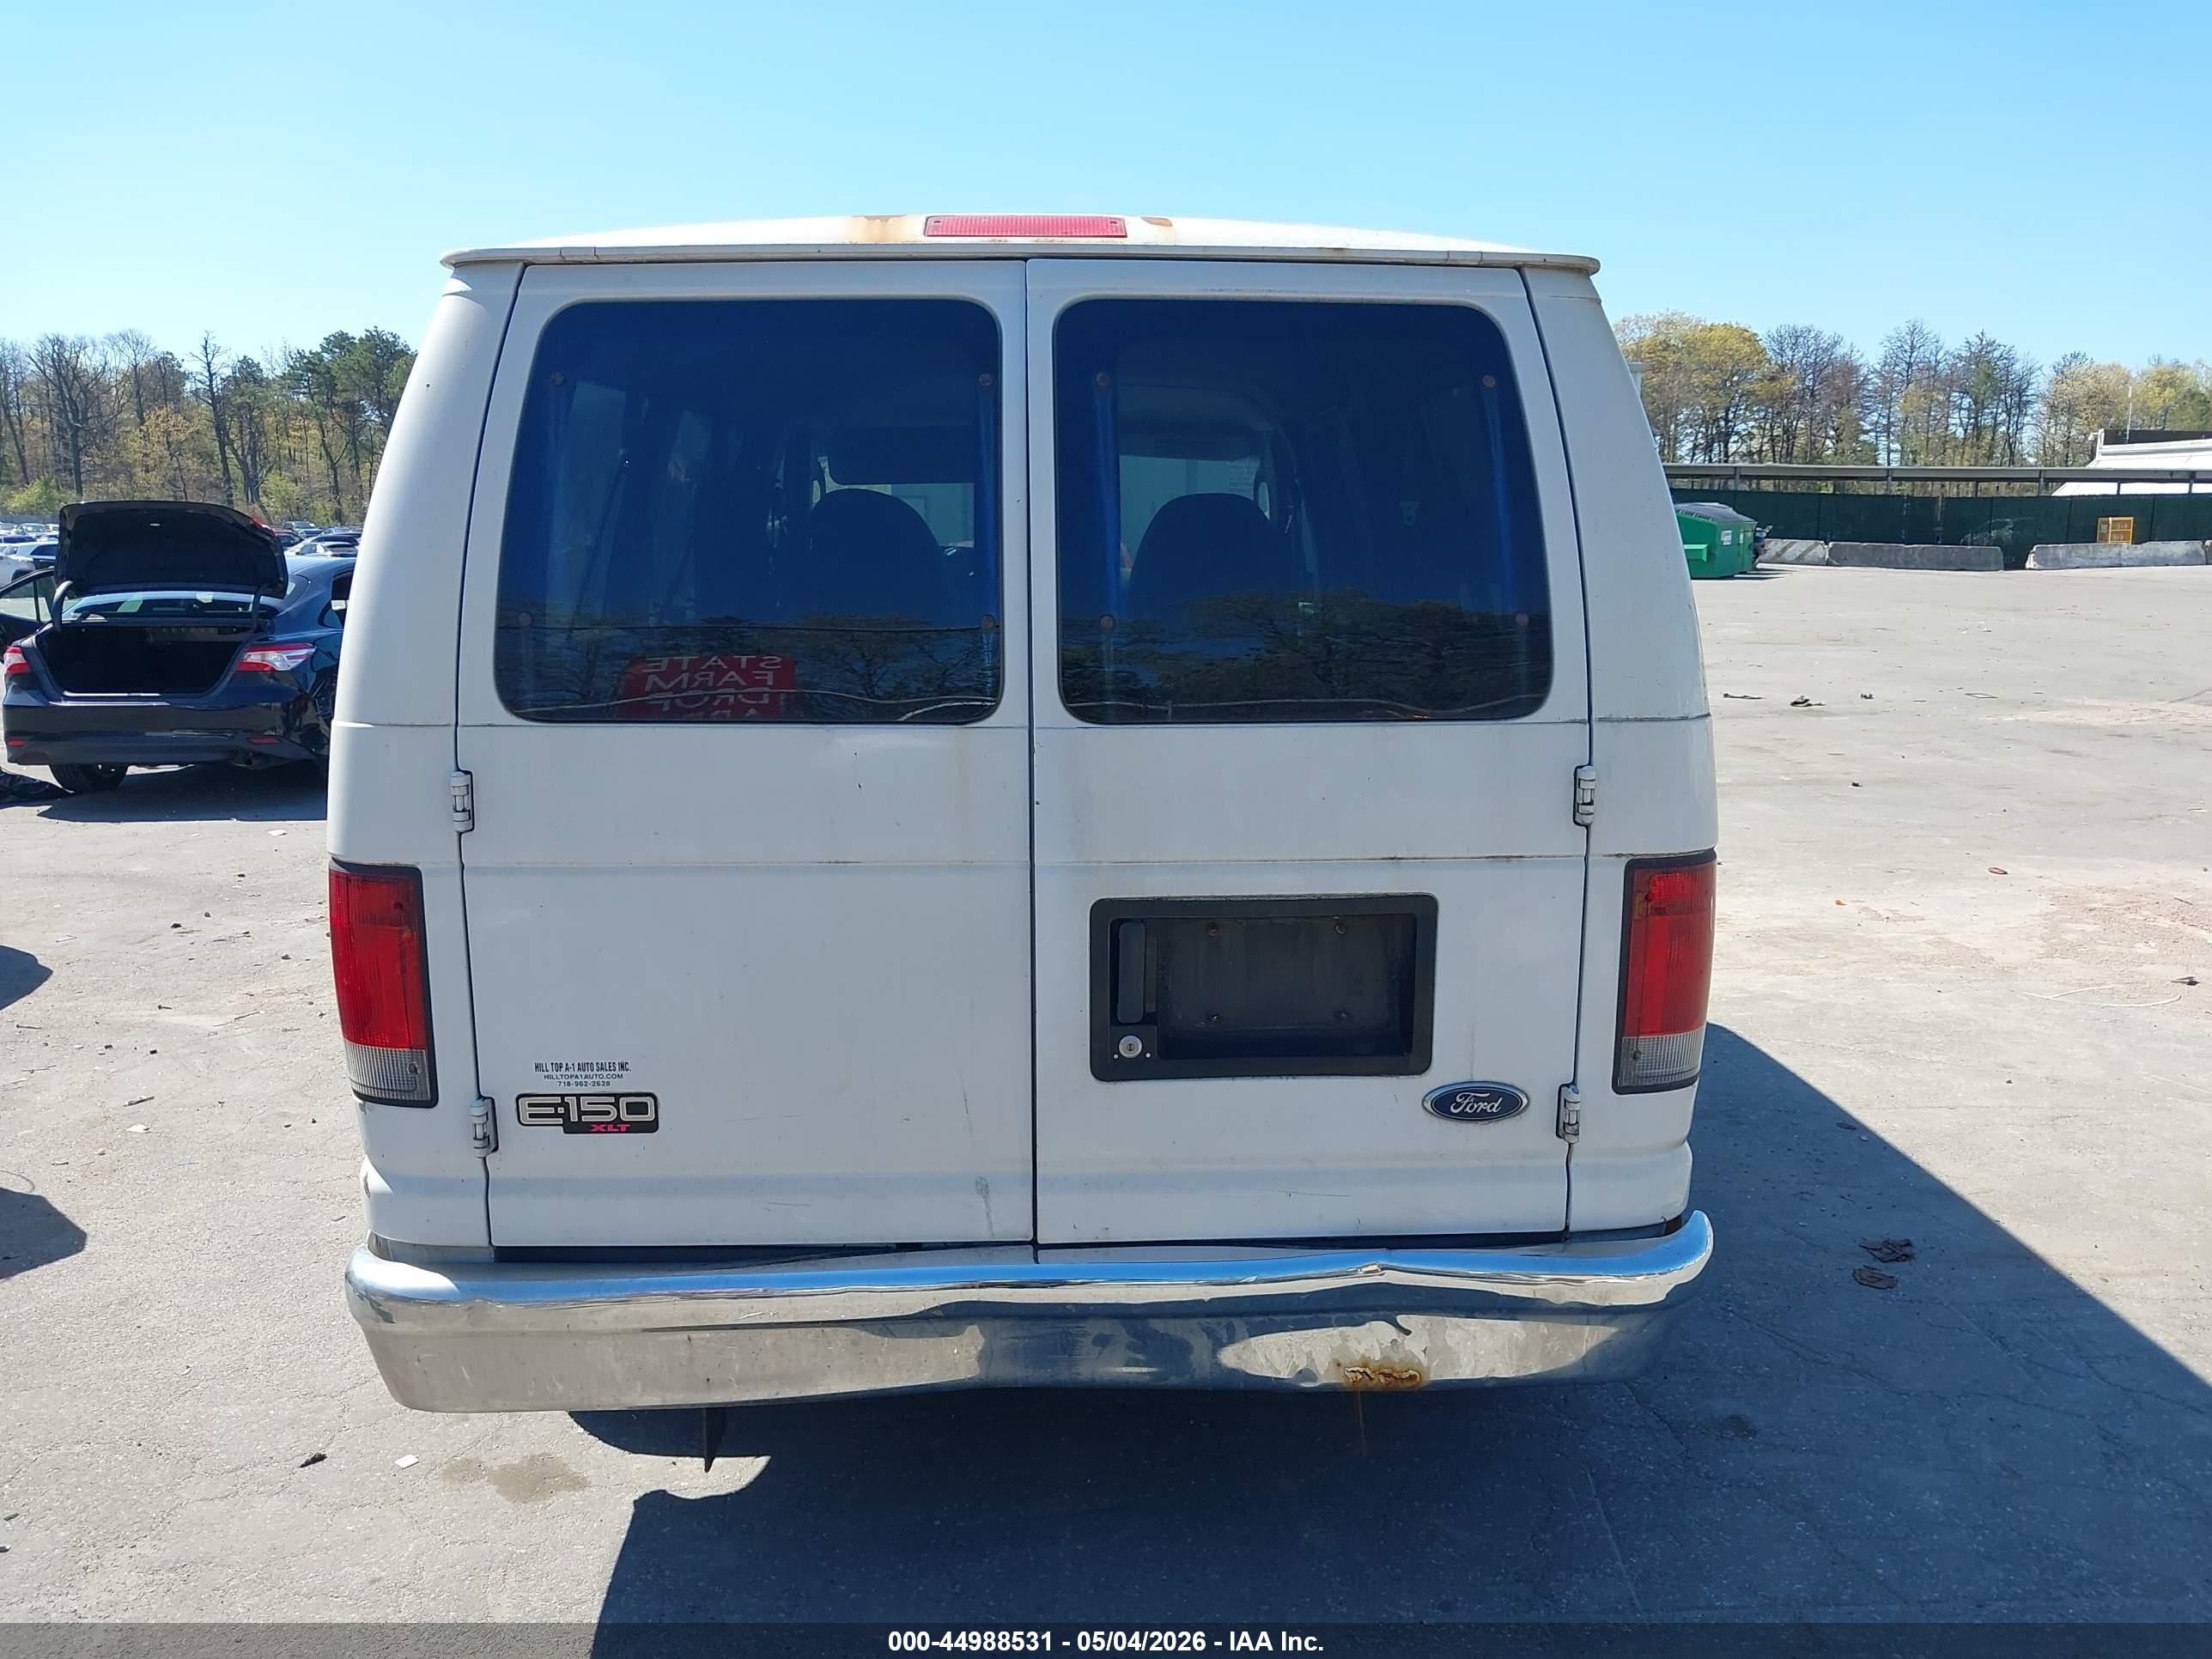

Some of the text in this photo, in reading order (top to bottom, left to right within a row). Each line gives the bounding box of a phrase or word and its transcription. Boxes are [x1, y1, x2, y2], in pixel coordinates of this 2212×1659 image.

[534, 1062, 550, 1073] HILL
[550, 1062, 563, 1073] TOP
[577, 1062, 594, 1073] AUTO
[596, 1061, 617, 1073] SALES
[617, 1061, 632, 1072] INC.
[1449, 1091, 1504, 1114] Ford
[590, 1123, 632, 1132] XLT
